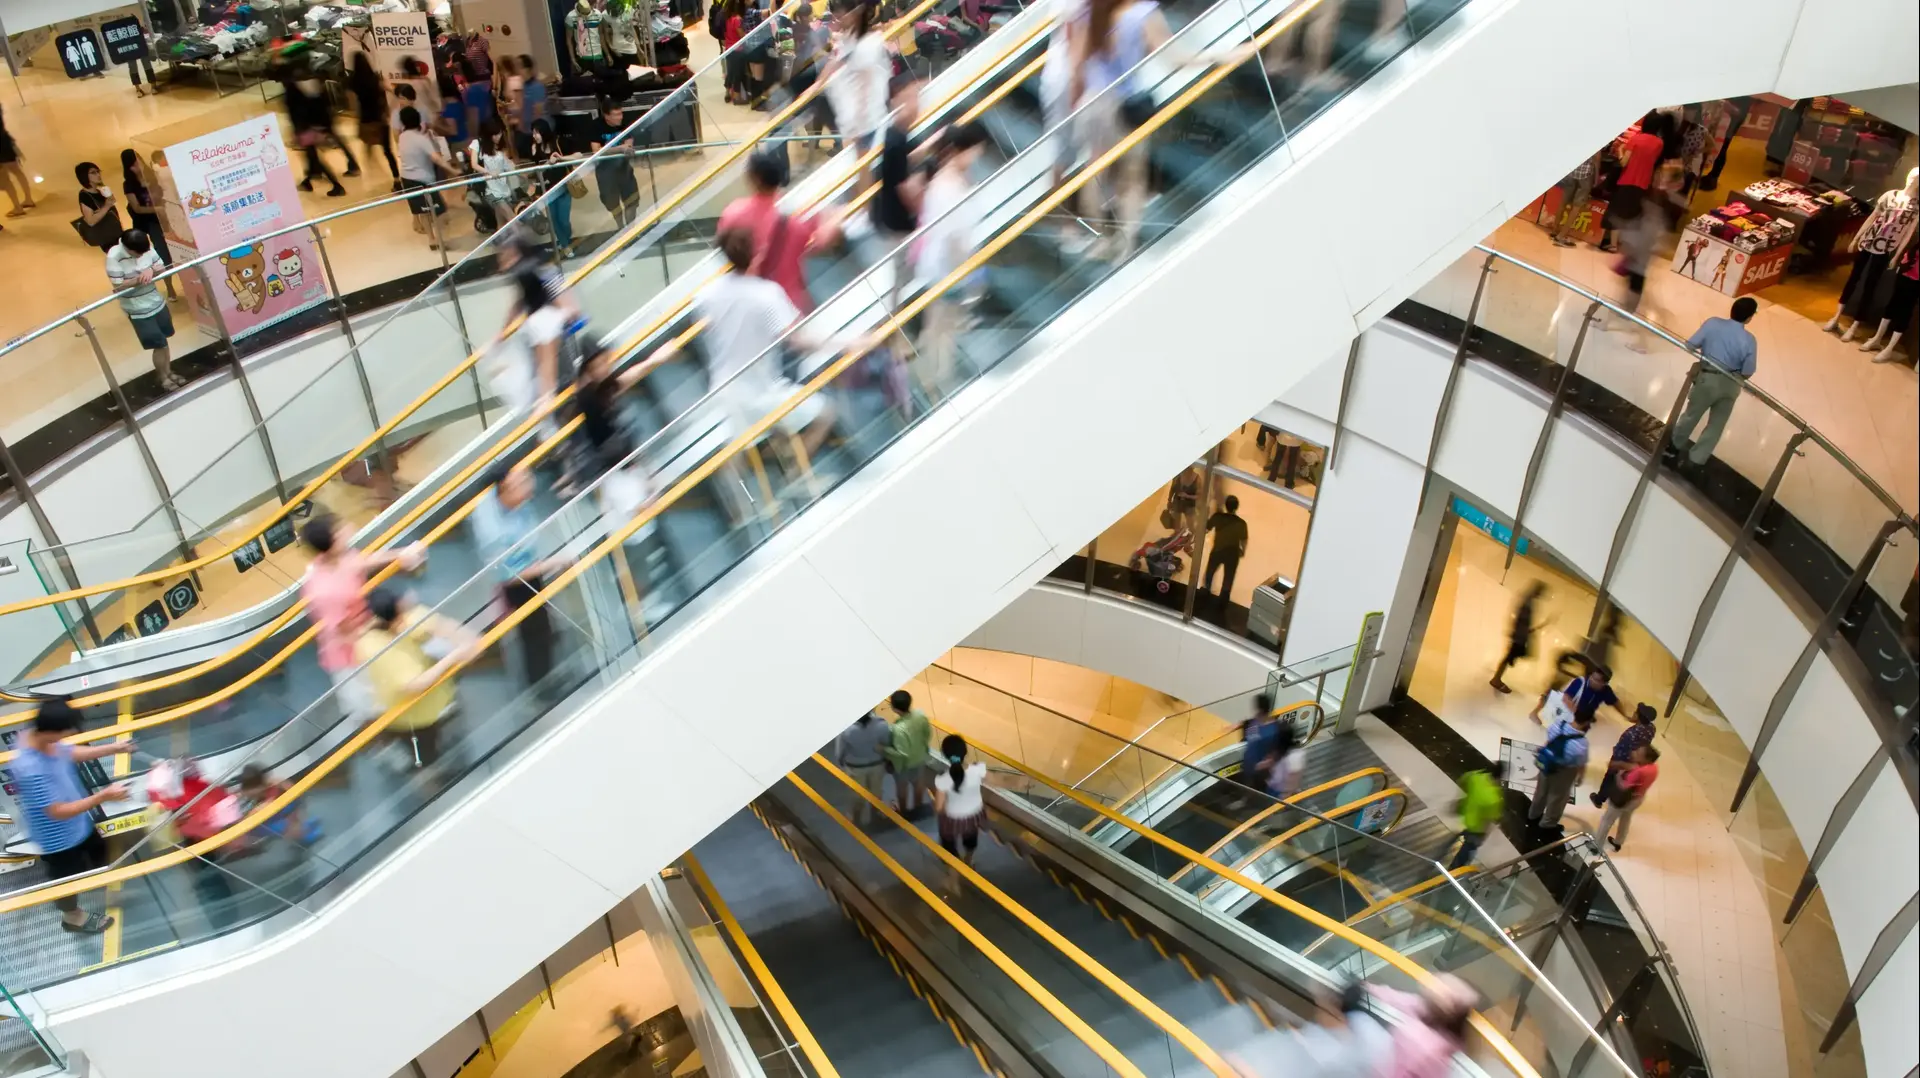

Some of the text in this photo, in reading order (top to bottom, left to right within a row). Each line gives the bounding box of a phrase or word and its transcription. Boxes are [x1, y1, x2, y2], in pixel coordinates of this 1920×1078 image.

[105, 24, 140, 43] 藍鯨館
[375, 26, 427, 36] SPECIAL
[378, 36, 414, 46] PRICE
[189, 137, 255, 164] Rilakkuma
[221, 191, 266, 215] 滿額集點送
[1743, 257, 1785, 285] SALE
[176, 589, 187, 607] P
